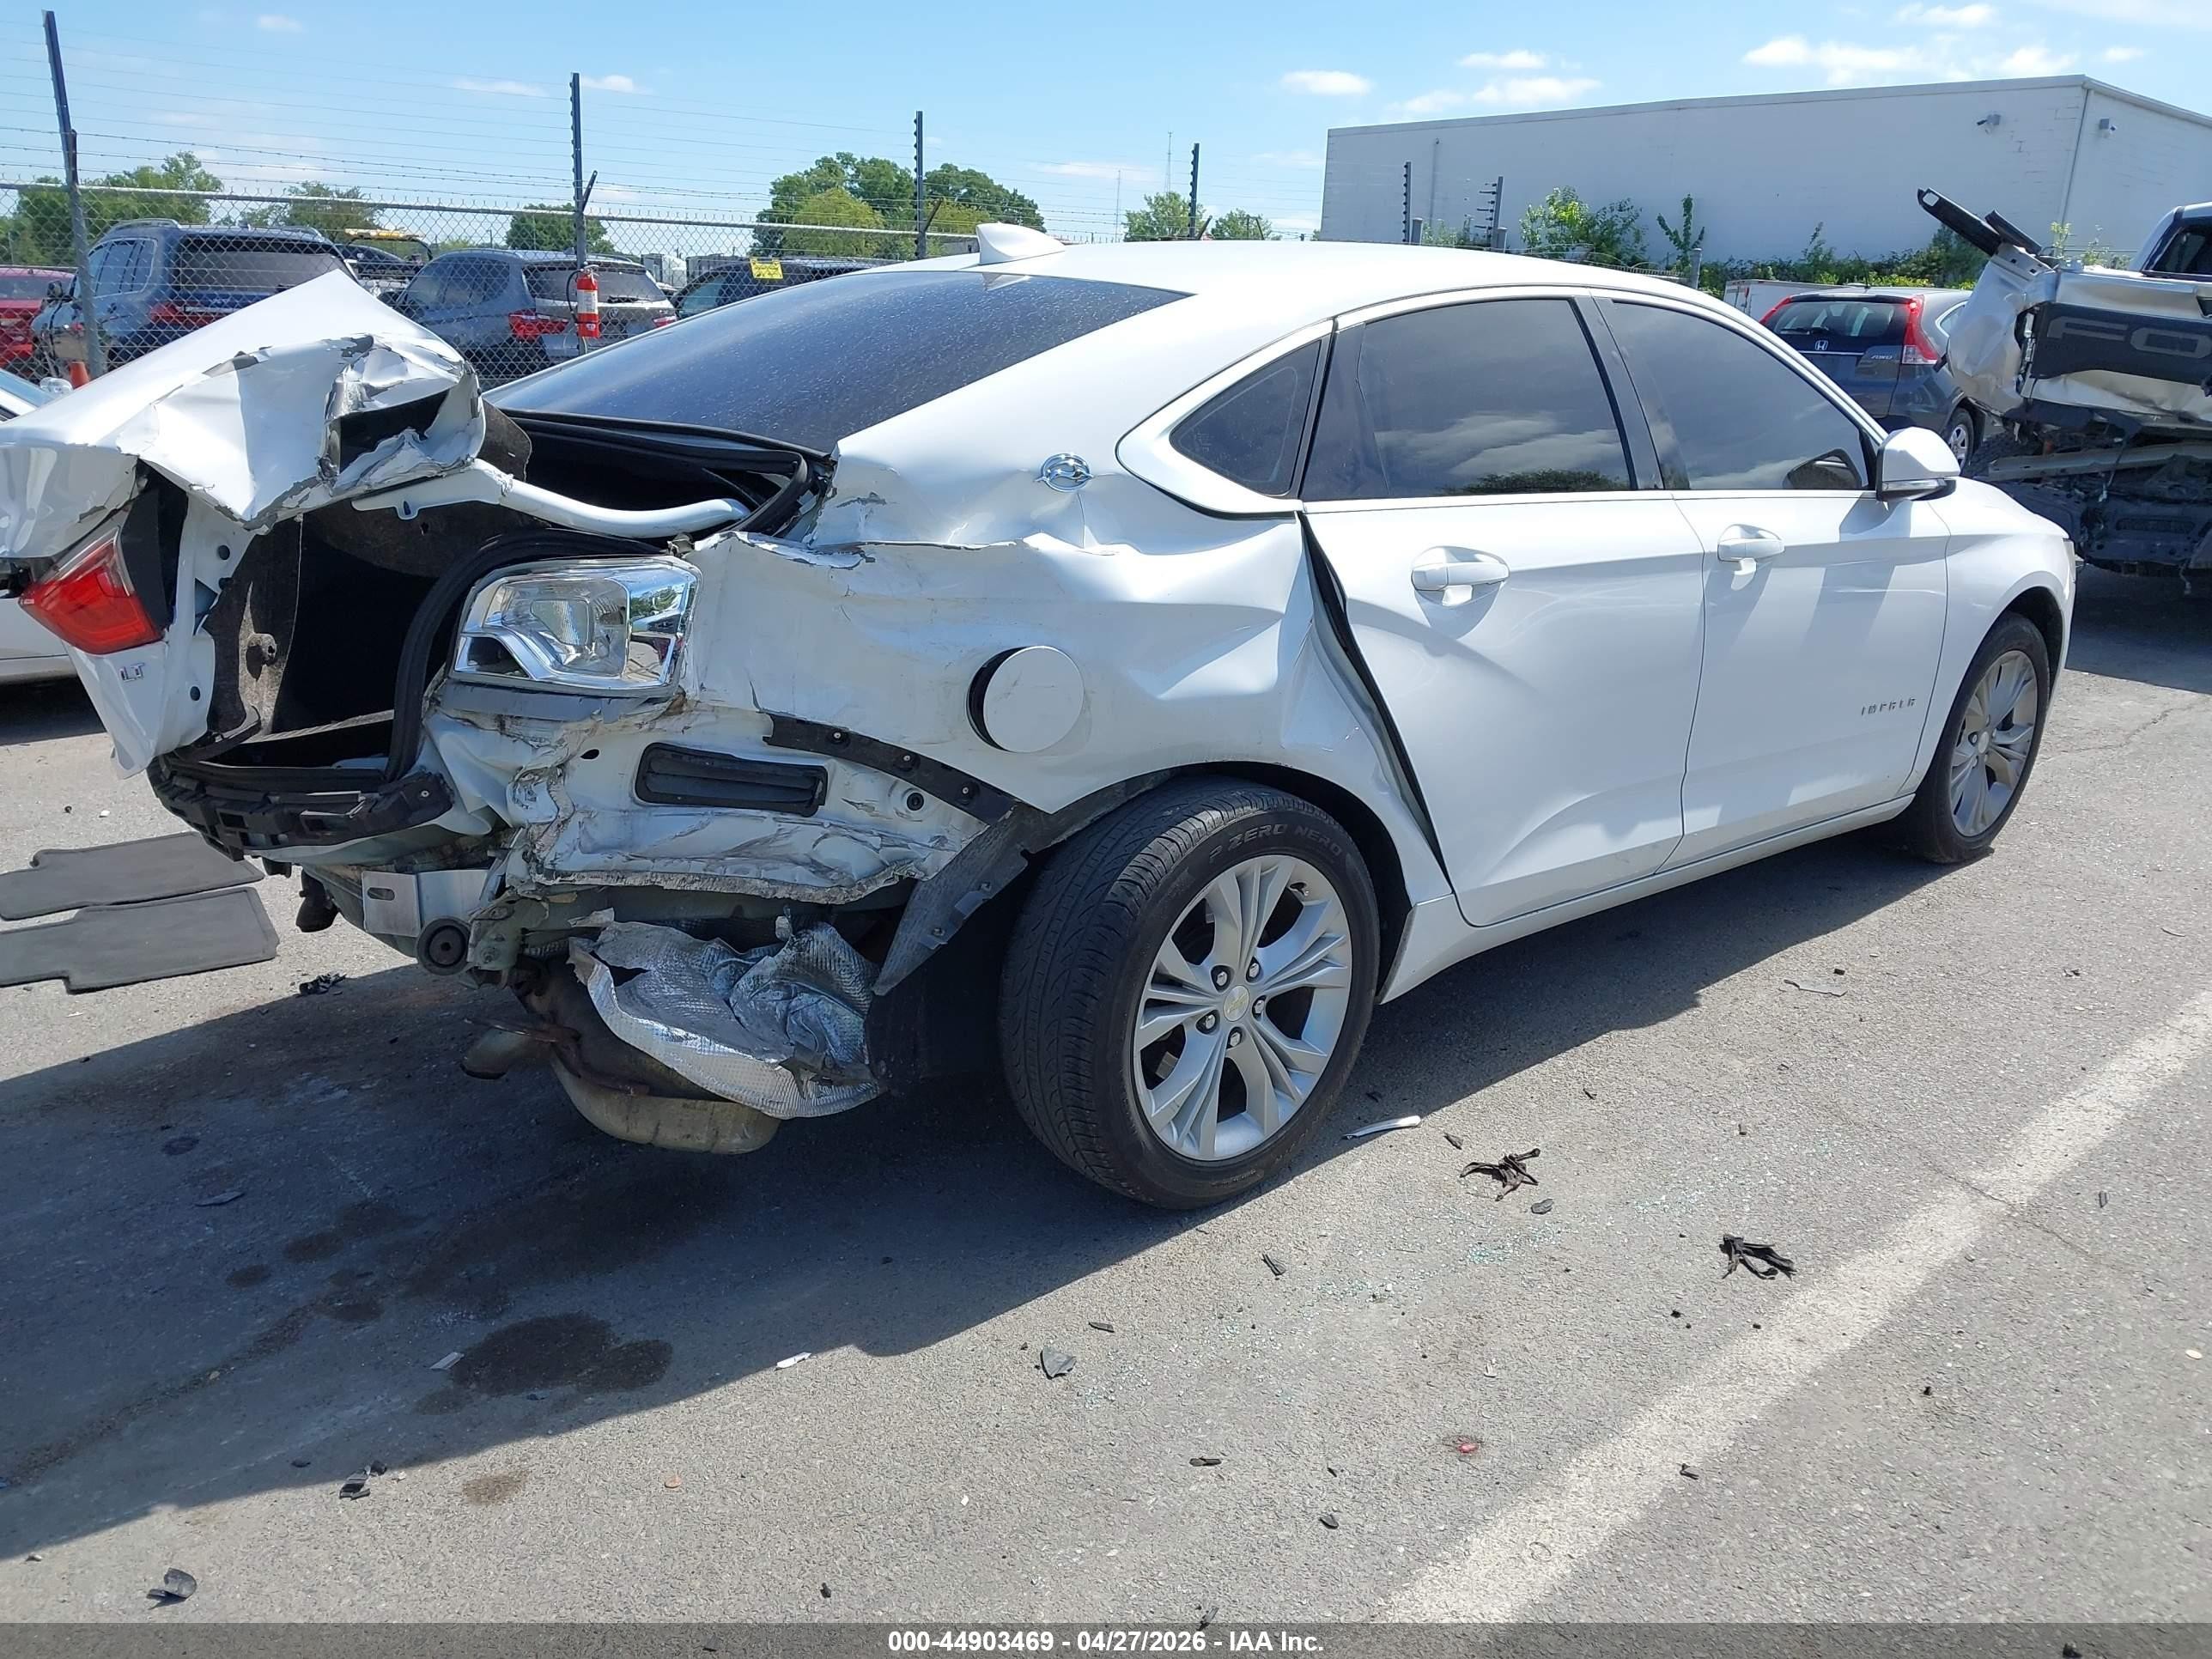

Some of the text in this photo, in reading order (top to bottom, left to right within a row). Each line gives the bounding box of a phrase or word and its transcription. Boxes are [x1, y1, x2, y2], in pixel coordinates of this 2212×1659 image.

[119, 662, 145, 683] LT
[1228, 823, 1288, 852] ZERO
[1294, 824, 1342, 857] NERO
